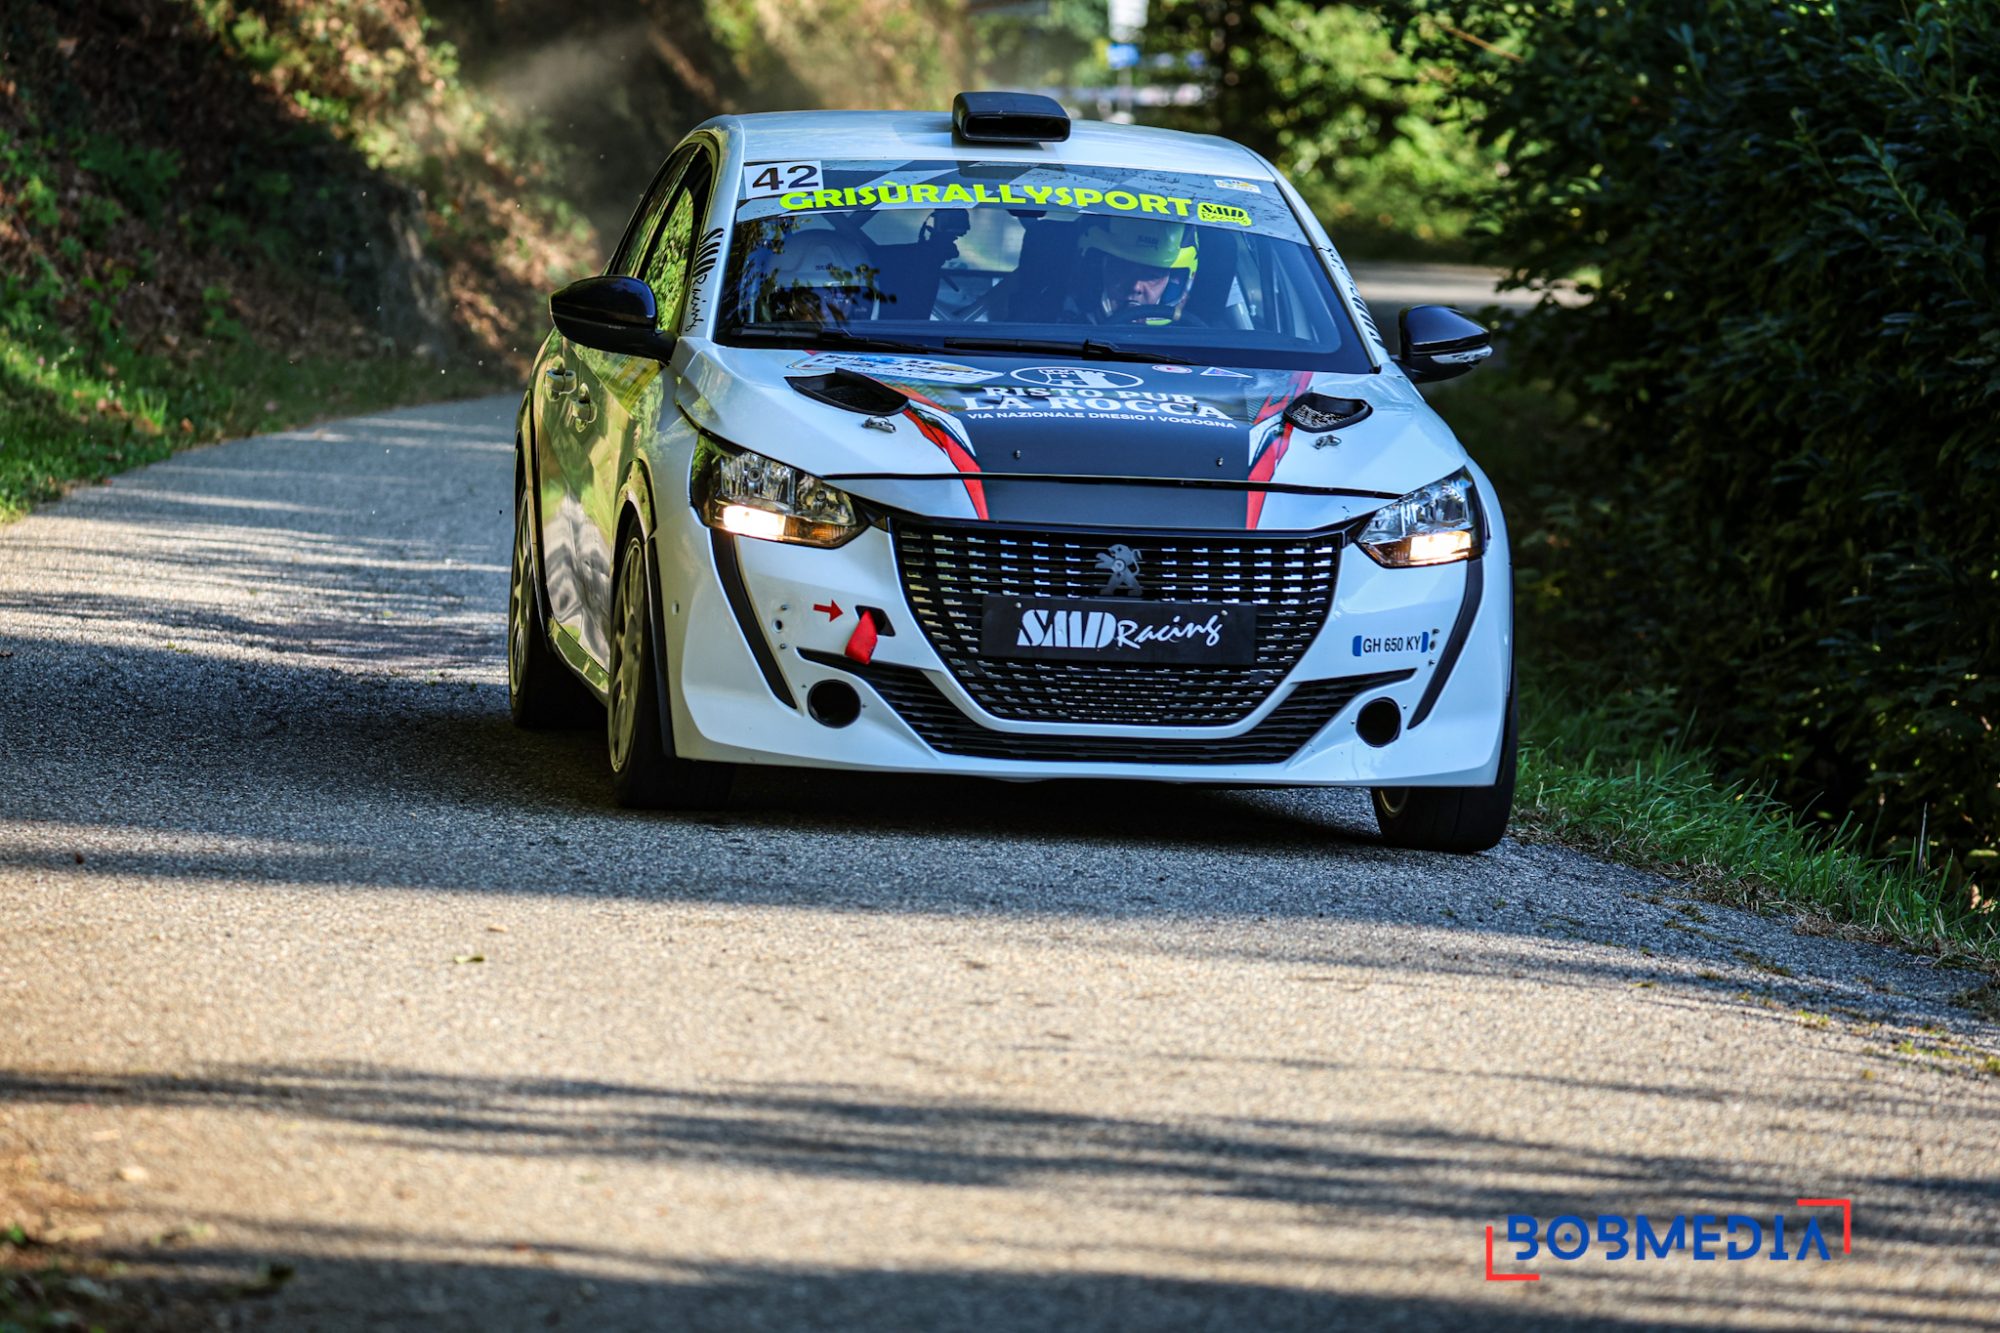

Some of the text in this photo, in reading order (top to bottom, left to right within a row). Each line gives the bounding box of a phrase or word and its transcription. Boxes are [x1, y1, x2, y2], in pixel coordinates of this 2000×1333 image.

[752, 165, 820, 191] 42
[984, 387, 1199, 404] RISTO PUB
[963, 396, 1234, 421] LA ROCCA
[1088, 413, 1146, 421] DRESIO
[1157, 416, 1238, 429] VOGOGNA
[1017, 609, 1223, 649] SMD Racing
[1362, 635, 1421, 653] GH 650 KY
